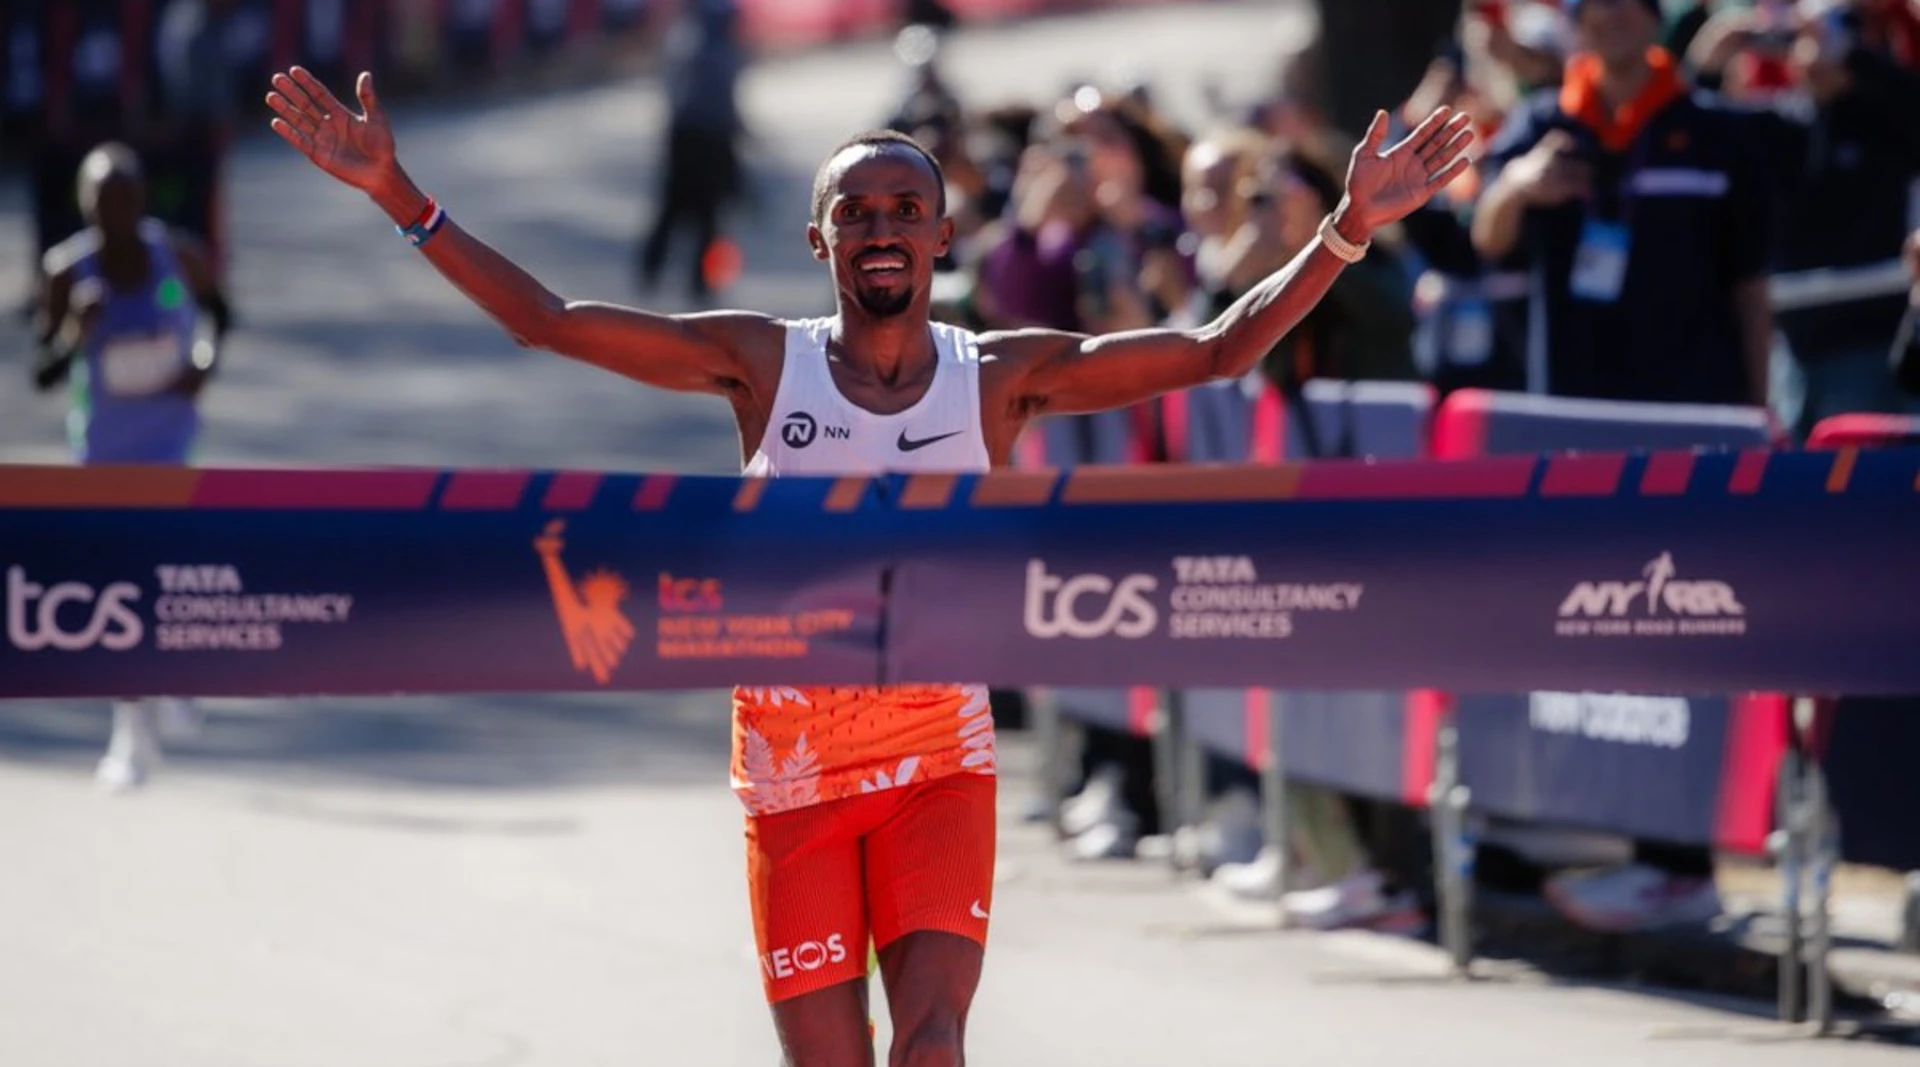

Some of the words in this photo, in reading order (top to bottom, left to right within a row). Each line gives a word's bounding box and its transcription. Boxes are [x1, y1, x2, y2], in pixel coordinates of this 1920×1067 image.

[824, 425, 849, 439] NN
[155, 564, 242, 592] TATA
[1172, 556, 1257, 581] TATA
[658, 572, 722, 611] tcs
[1024, 558, 1158, 639] tcs
[1169, 583, 1363, 610] CONSULTANCY
[7, 566, 143, 650] tcs
[154, 593, 353, 622] CONSULTANCY
[155, 622, 282, 650] SERVICES
[1169, 611, 1292, 638] SERVICES
